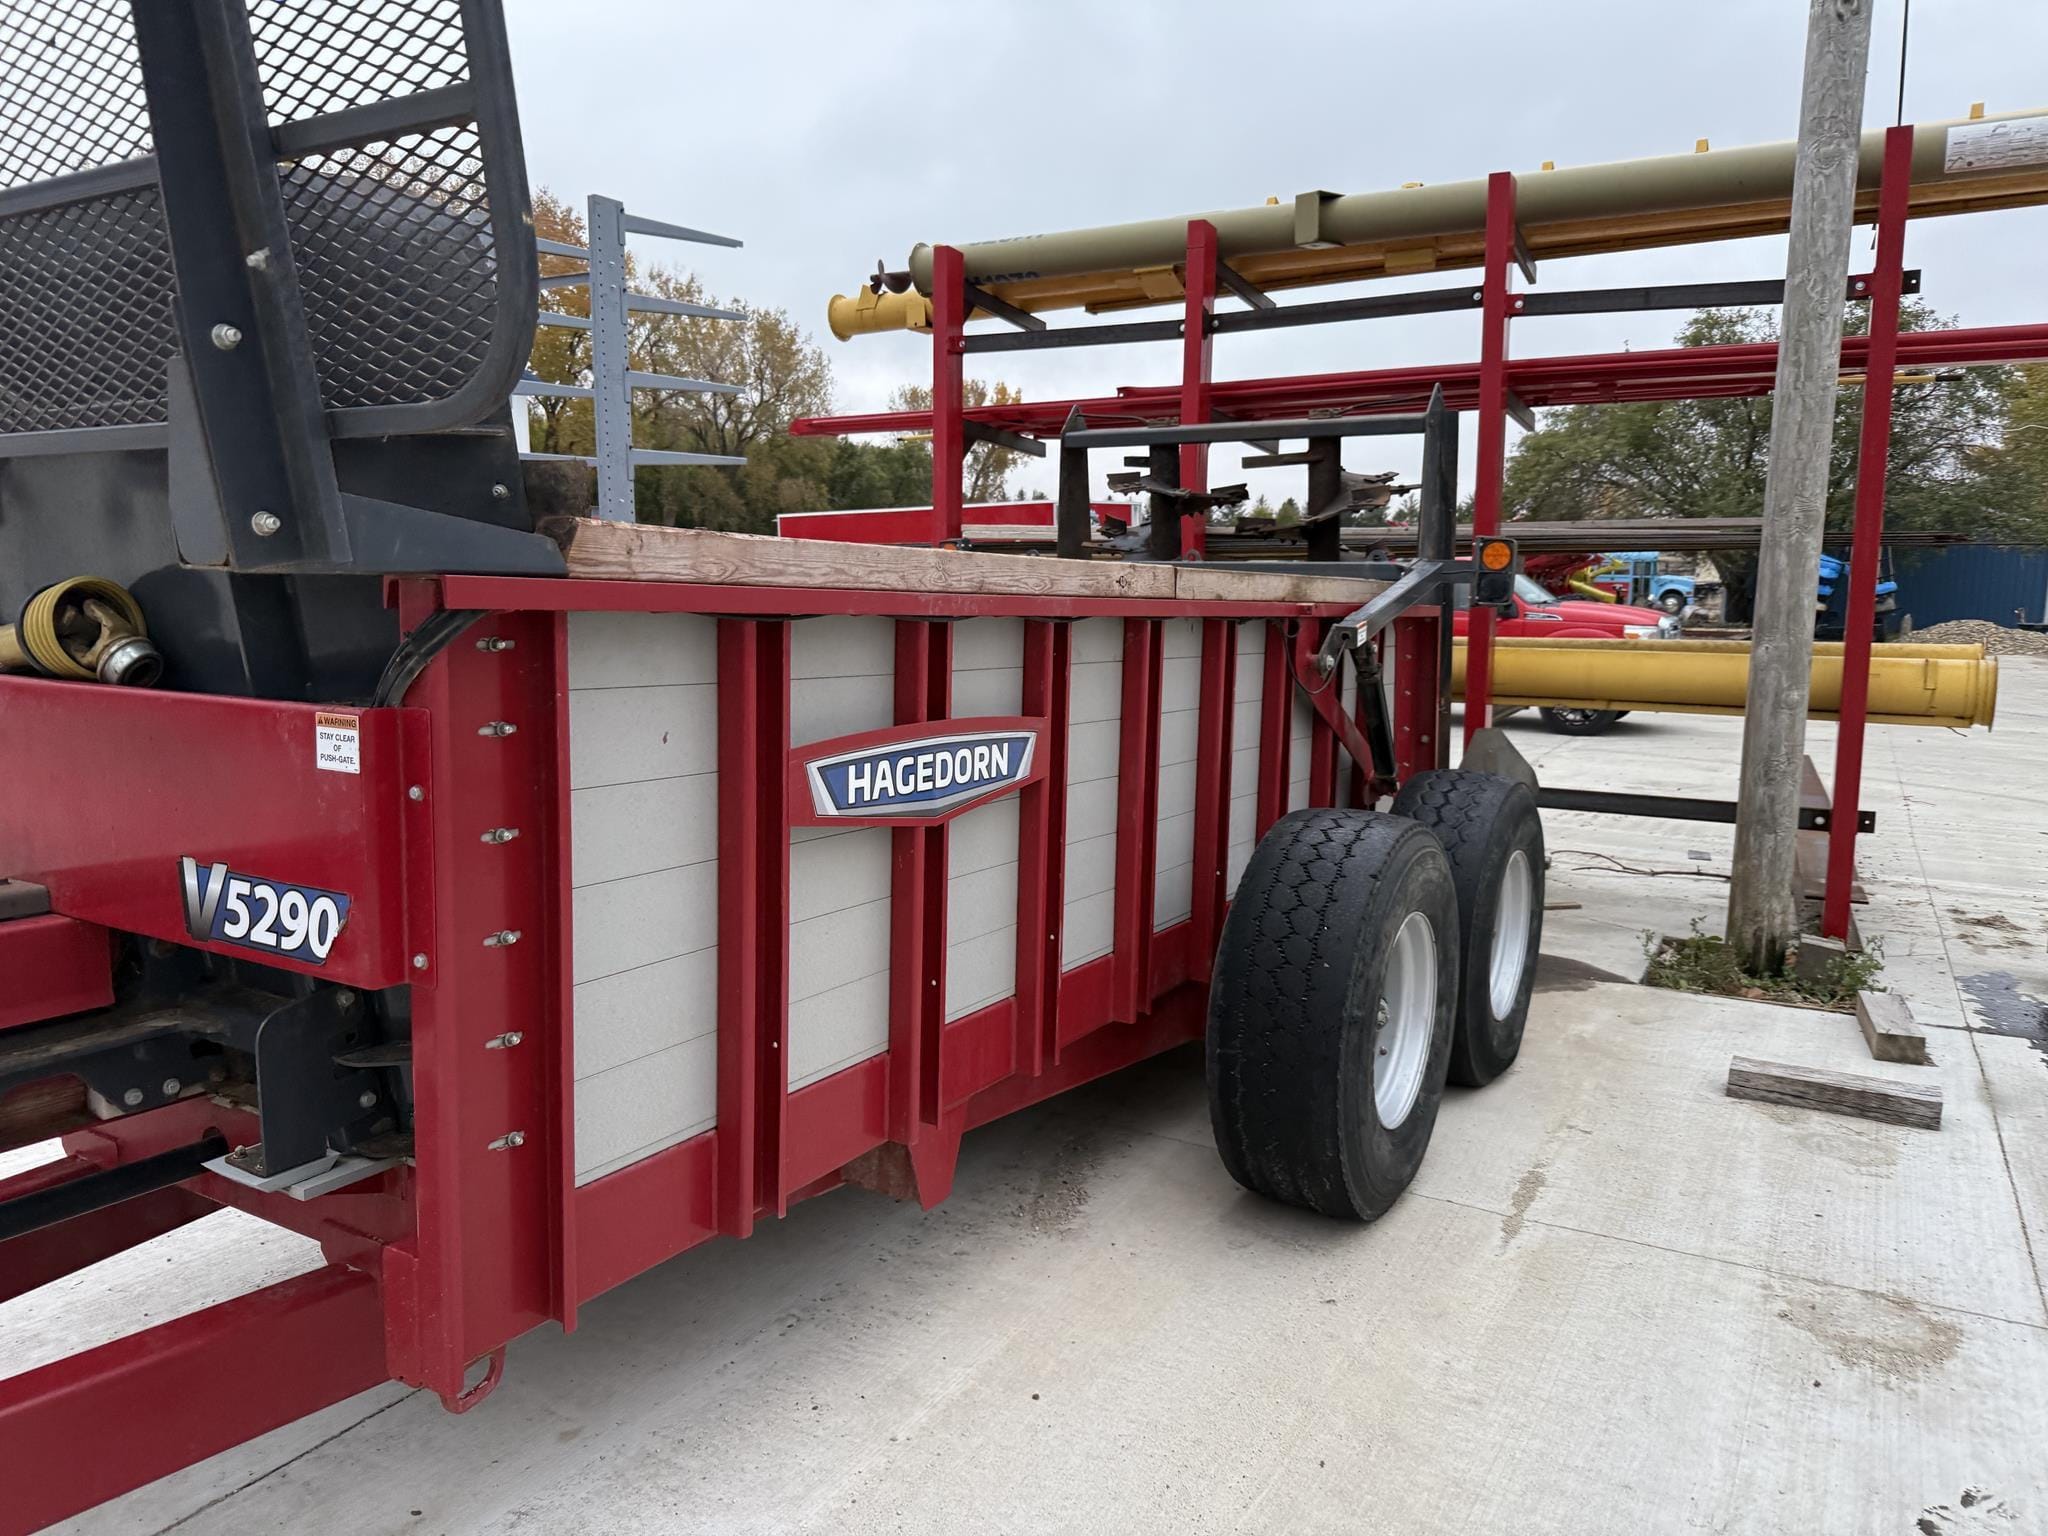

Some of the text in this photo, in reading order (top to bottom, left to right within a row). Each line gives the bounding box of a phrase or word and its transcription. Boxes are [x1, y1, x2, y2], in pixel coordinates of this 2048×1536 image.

[324, 716, 356, 727] WARNING
[319, 732, 355, 742] STAY CLEAR
[320, 753, 355, 764] PUSH-GATE.
[847, 742, 1009, 805] HAGEDORN
[179, 855, 340, 960] V5290
